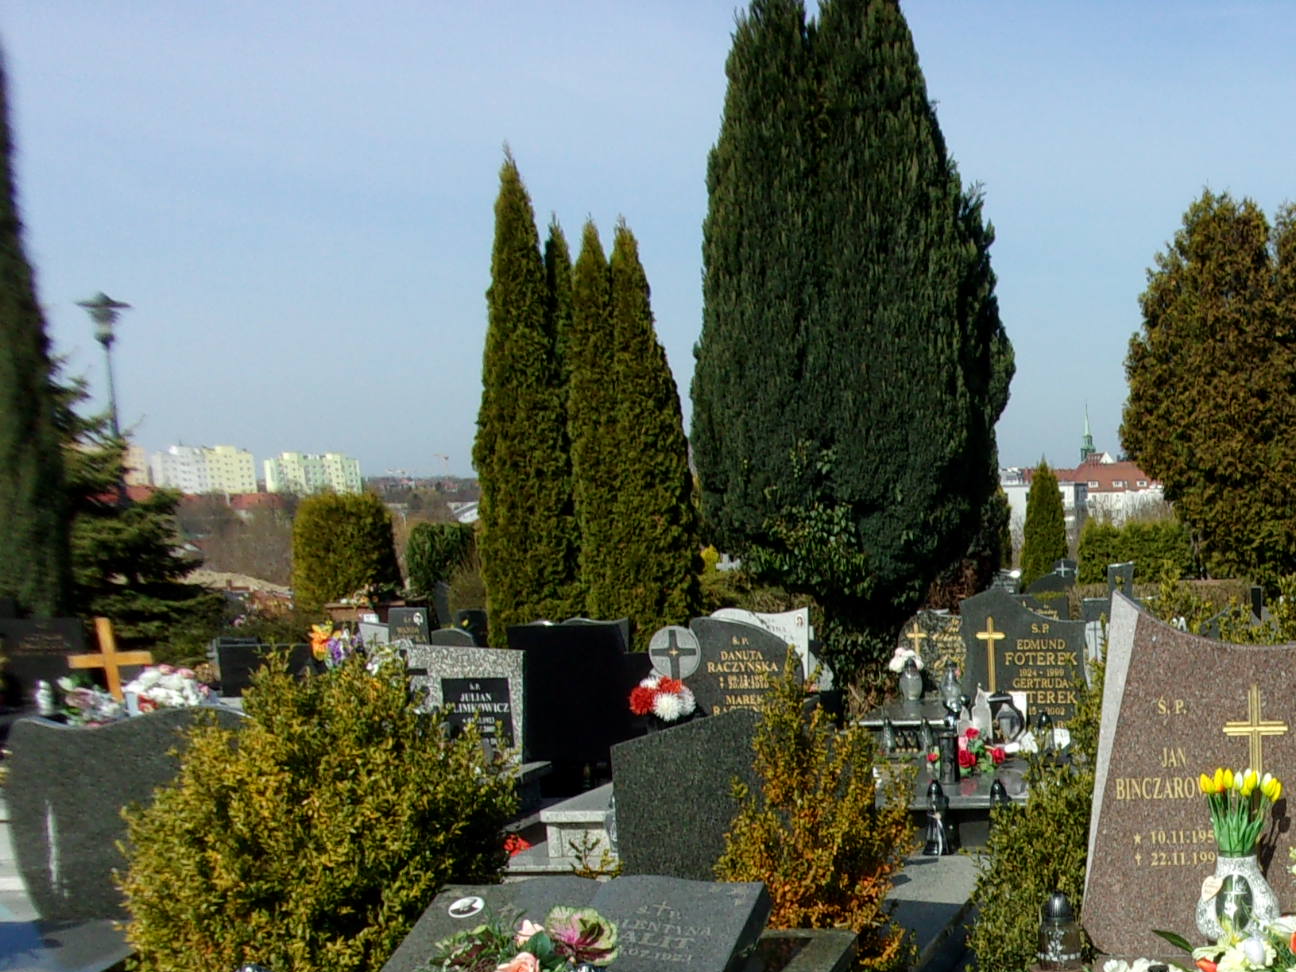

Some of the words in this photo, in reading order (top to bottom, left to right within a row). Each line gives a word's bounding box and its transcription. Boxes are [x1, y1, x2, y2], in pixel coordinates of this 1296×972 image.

[1016, 639, 1066, 650] EDMUND
[719, 650, 764, 661] DANUTA
[1004, 652, 1079, 666] FOTEREK
[706, 661, 779, 673] RACZYŃSKA
[1012, 677, 1069, 689] GERTRUDA
[460, 692, 492, 702] JULIAN
[725, 694, 765, 705] MAREK
[1026, 690, 1078, 704] TEREK
[1161, 747, 1188, 769] JAN
[1151, 831, 1214, 845] 10.11.195
